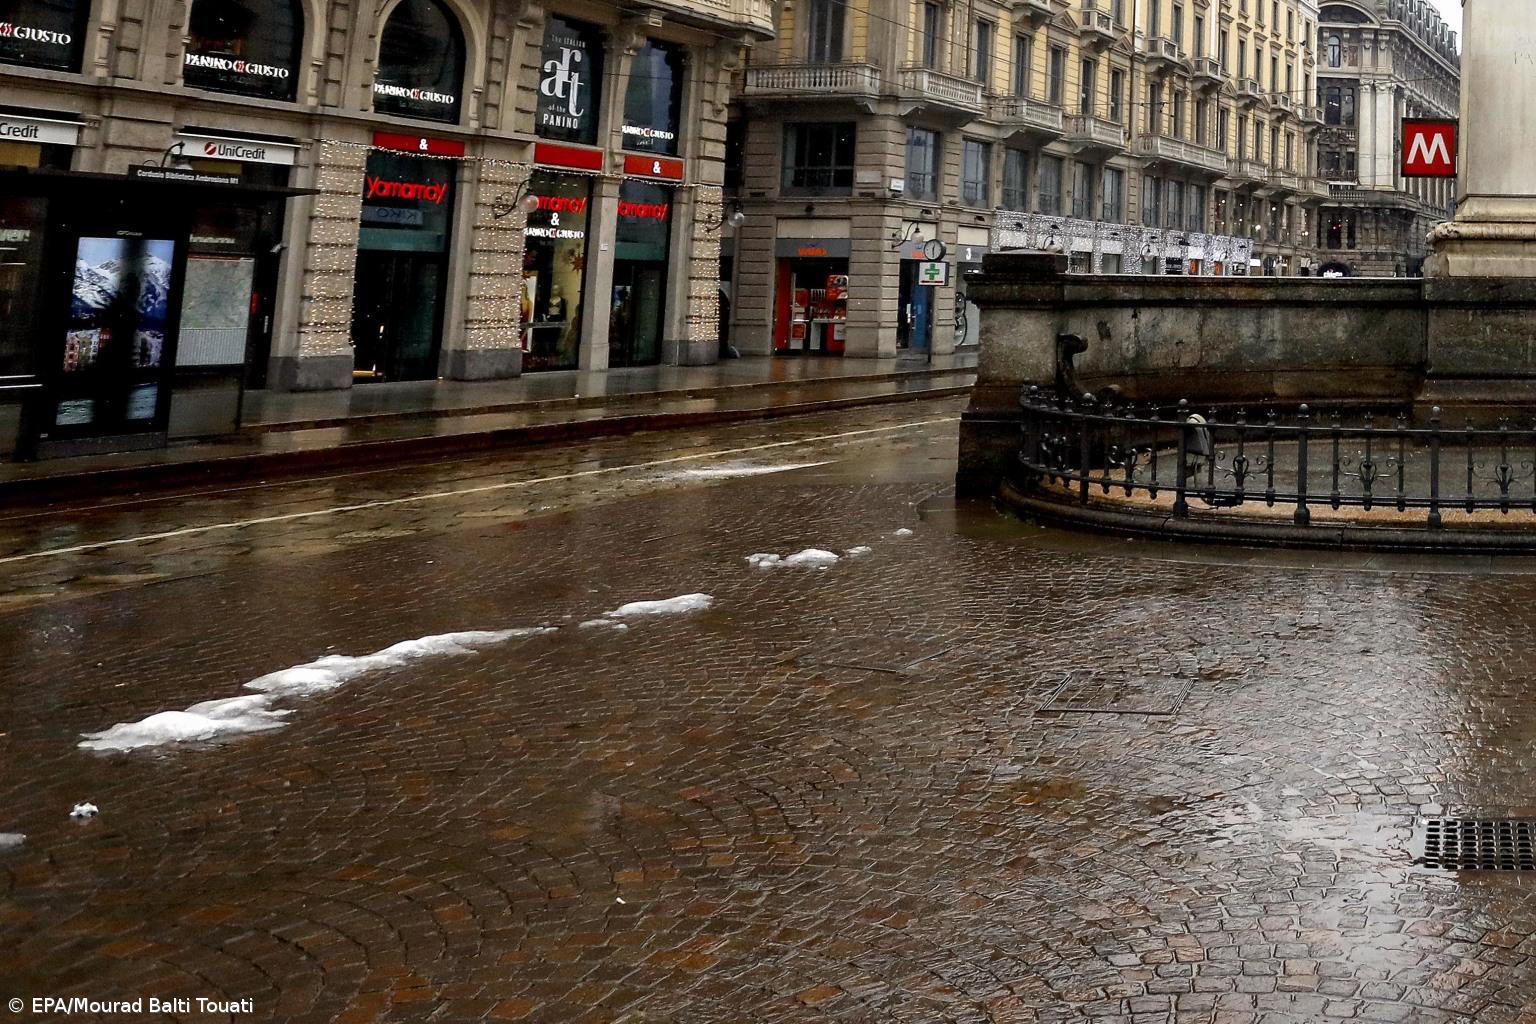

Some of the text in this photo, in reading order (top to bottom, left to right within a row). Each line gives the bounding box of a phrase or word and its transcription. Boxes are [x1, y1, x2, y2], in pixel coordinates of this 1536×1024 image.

[14, 26, 72, 45] GIUSTO
[245, 63, 289, 79] GIUSTO
[540, 46, 584, 117] art
[419, 91, 454, 105] GIUSTO
[543, 113, 578, 129] PANINO
[218, 144, 266, 160] UniCredit
[419, 138, 428, 150] &
[1407, 132, 1451, 165] M
[653, 161, 661, 174] &
[551, 212, 560, 226] &
